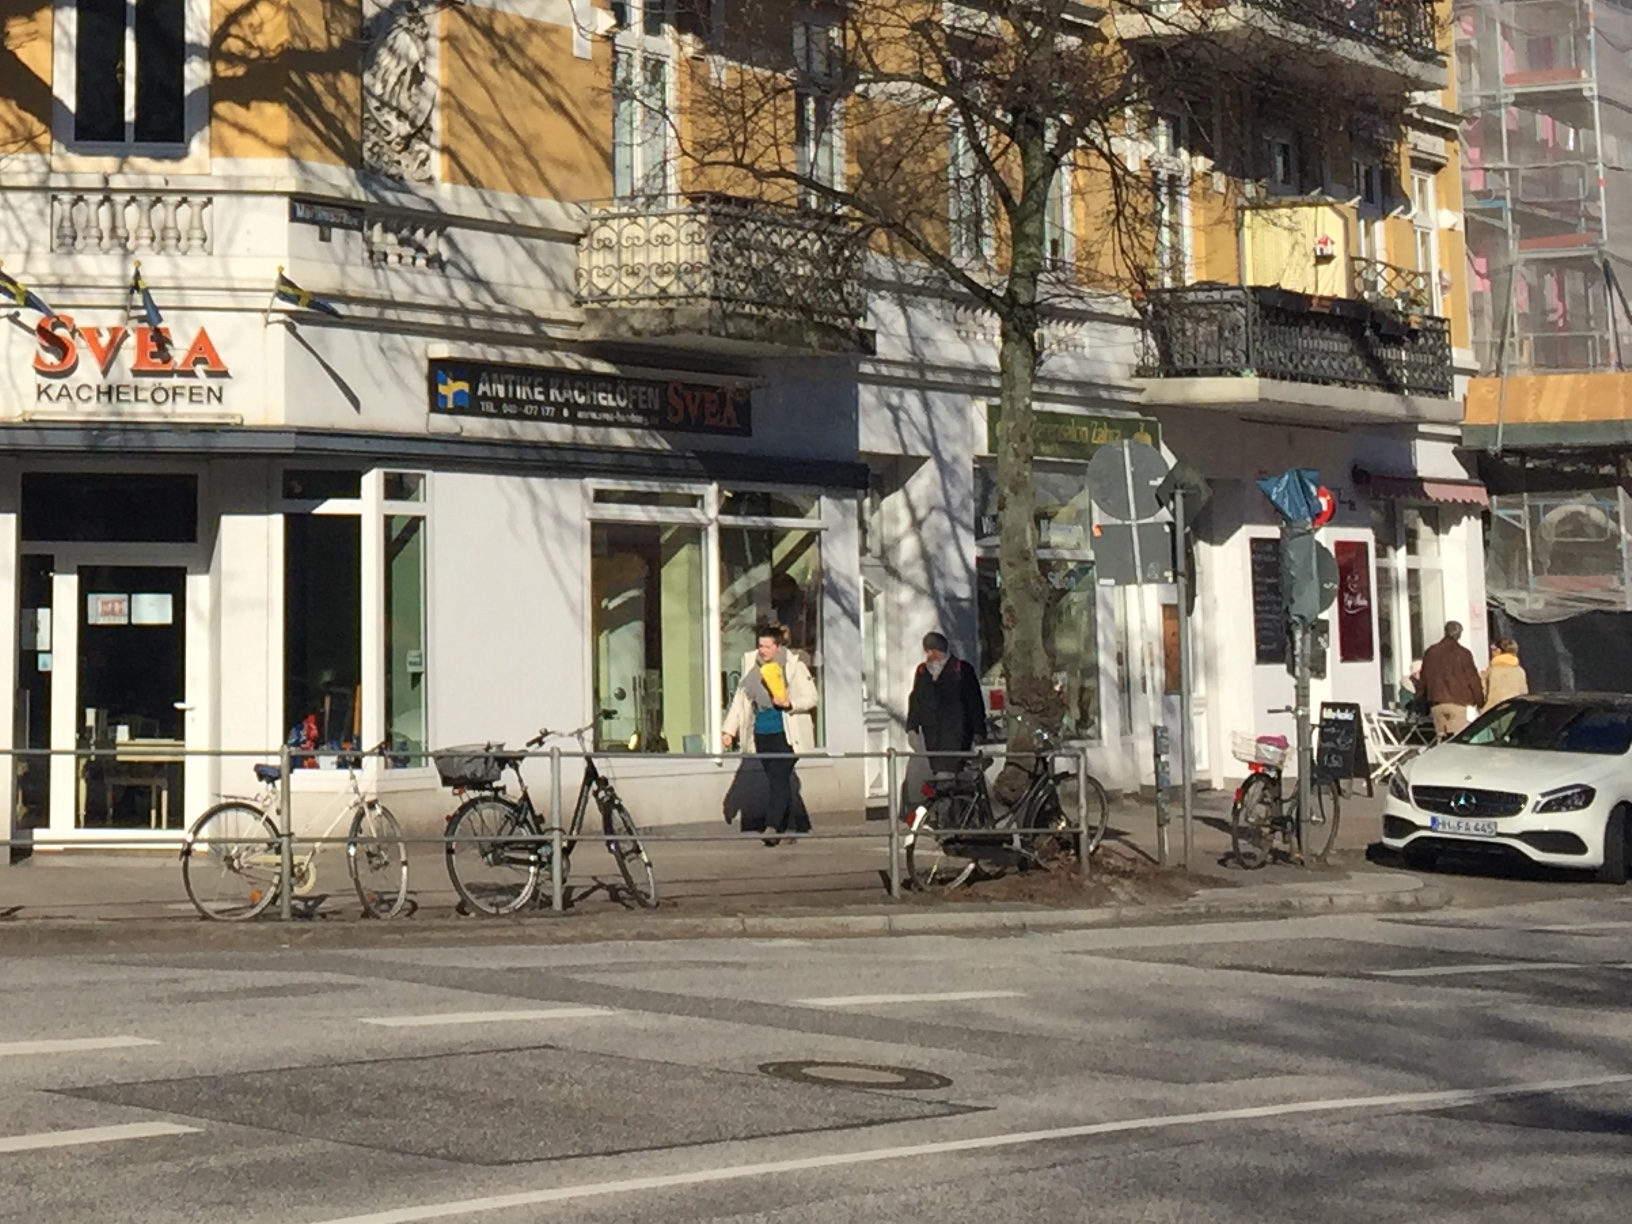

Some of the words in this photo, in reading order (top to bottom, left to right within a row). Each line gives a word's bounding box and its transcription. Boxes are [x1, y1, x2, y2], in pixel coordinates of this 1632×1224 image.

[32, 314, 230, 374] SVEA
[37, 383, 223, 405] KACHELÖFEN
[477, 372, 545, 400] ANTIKE
[550, 376, 659, 410] KACHELÖFEN
[669, 380, 740, 428] SVEA
